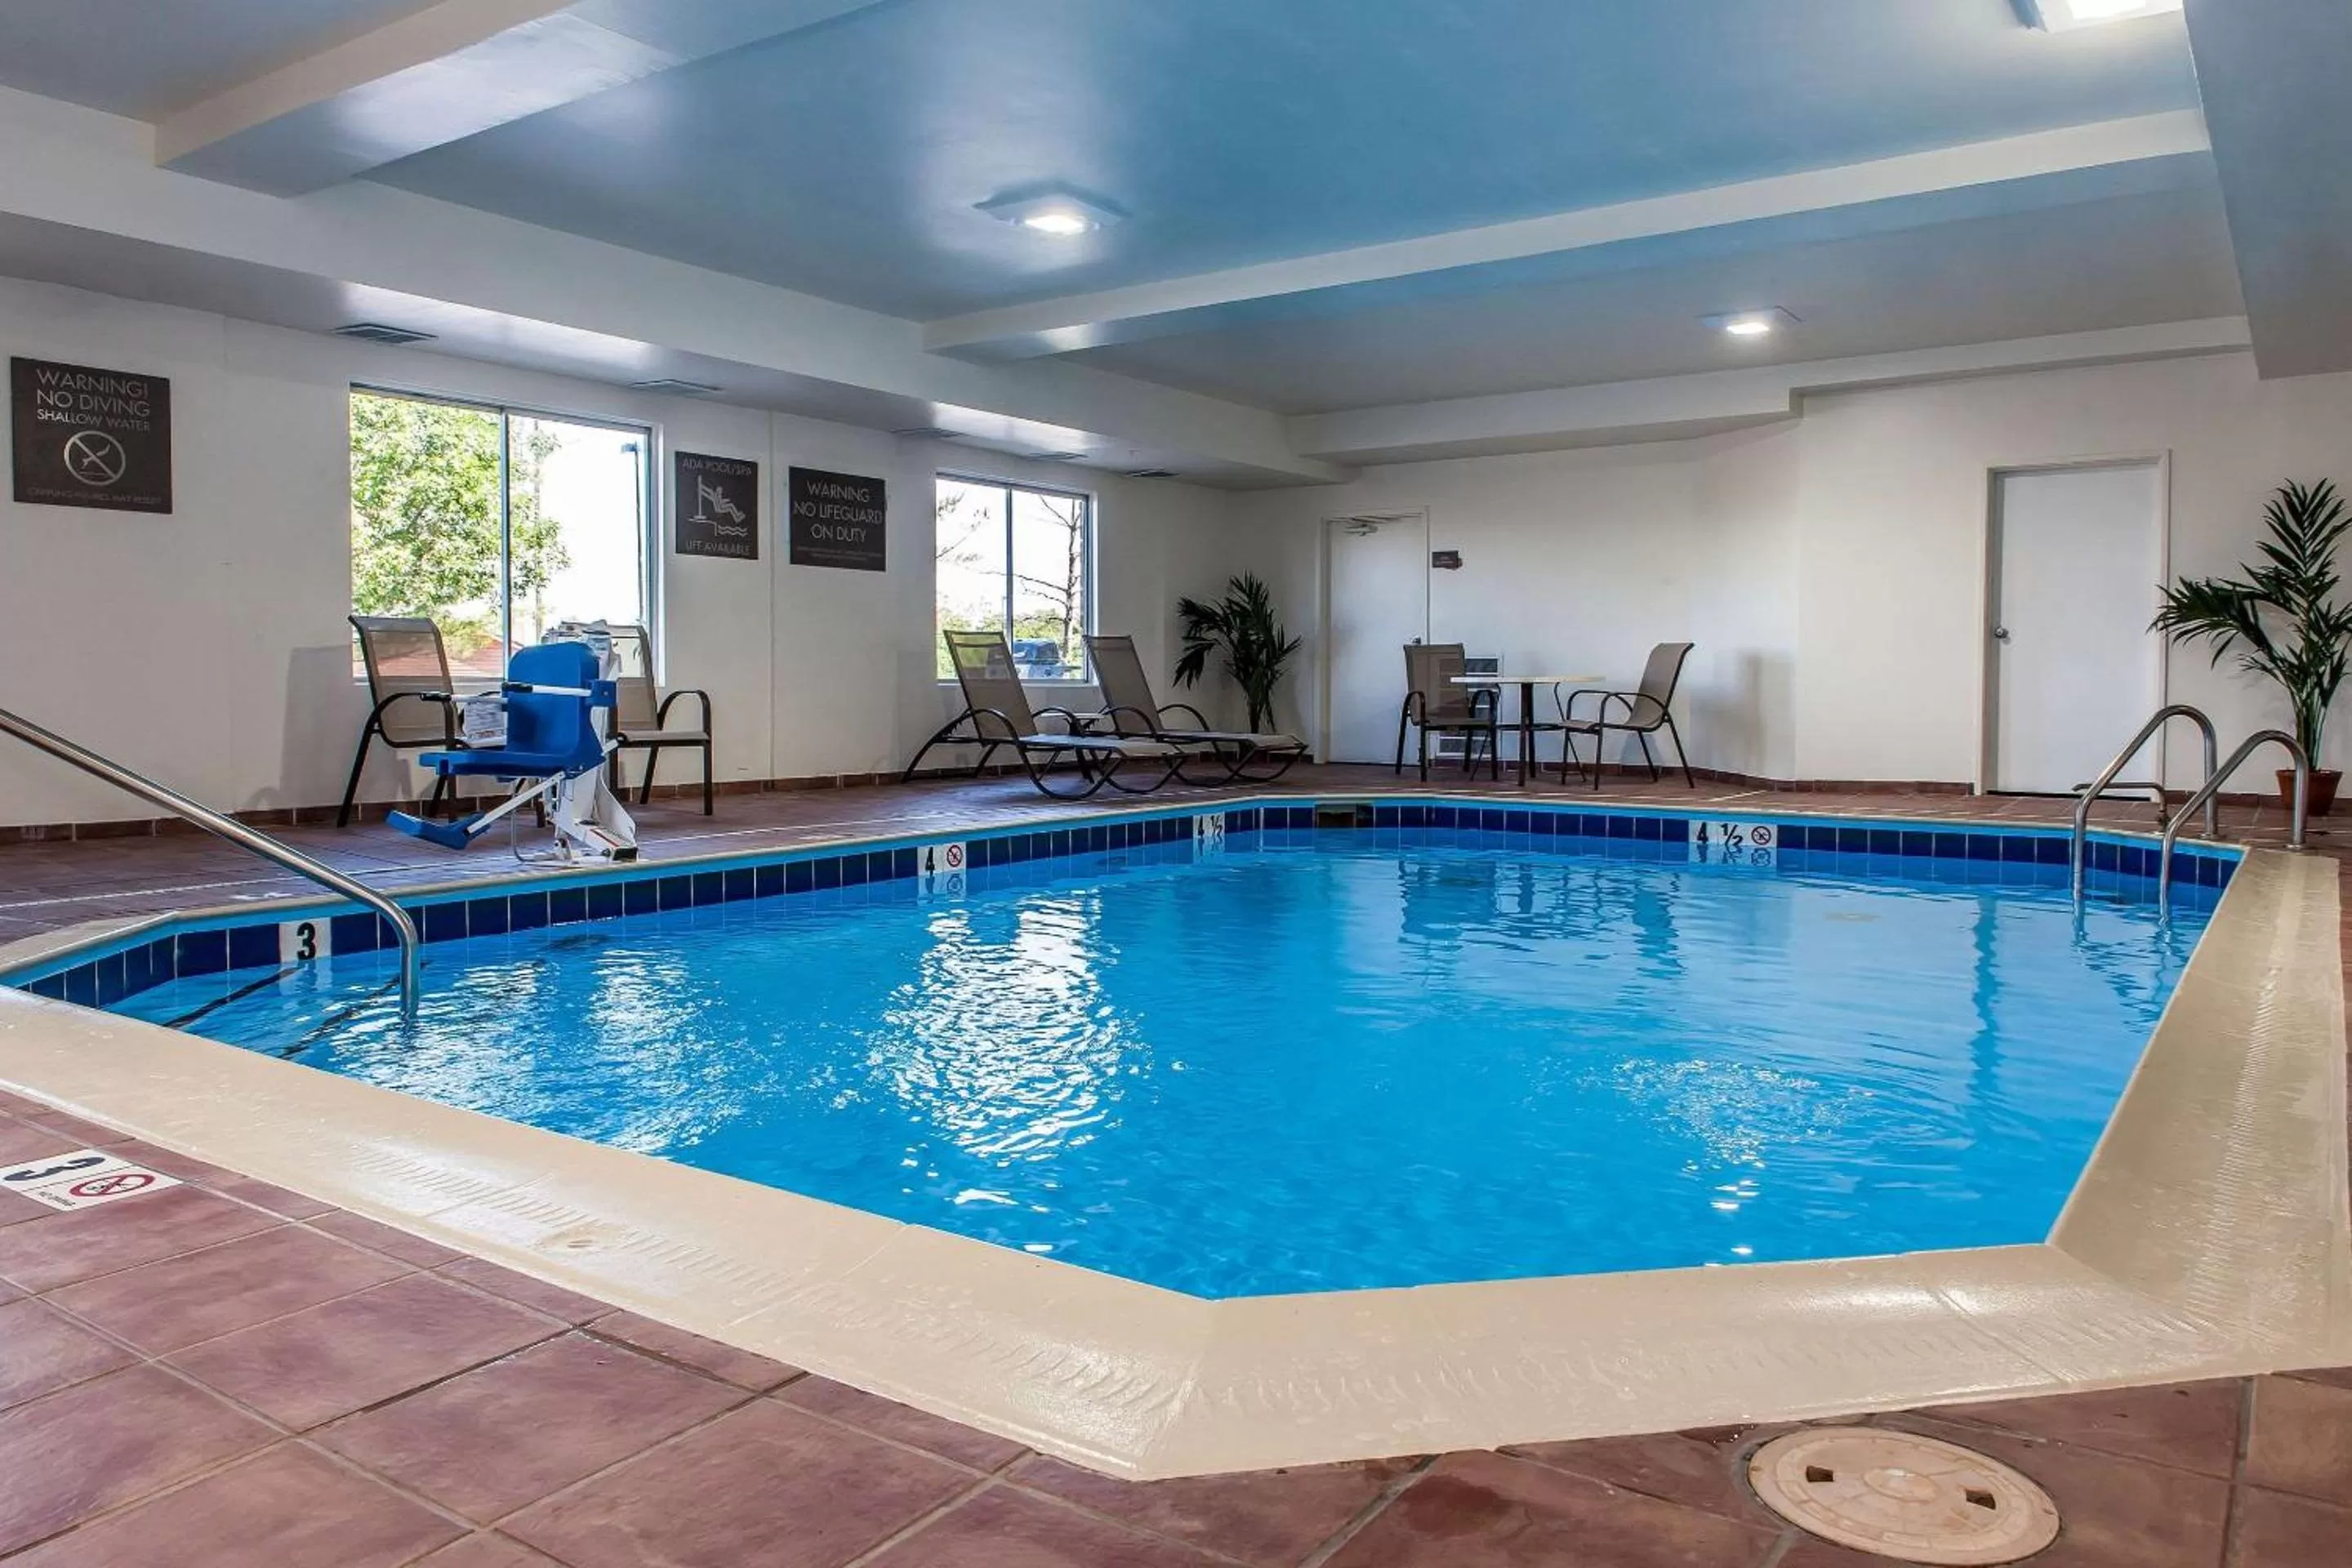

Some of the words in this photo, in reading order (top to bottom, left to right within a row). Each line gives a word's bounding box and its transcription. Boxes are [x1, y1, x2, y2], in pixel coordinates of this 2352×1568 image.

[36, 388, 74, 408] NO
[79, 394, 151, 417] DIVING
[37, 409, 103, 426] SHALLOW
[106, 416, 150, 431] WATER
[682, 457, 703, 472] ADA
[805, 479, 870, 504] WARNING
[794, 499, 817, 518] NO
[819, 502, 884, 525] LIFEGUARD
[811, 523, 834, 541] ON
[836, 526, 866, 544] DUTY
[686, 539, 703, 550] LIFT
[705, 541, 751, 556] AVAILABLE
[1197, 815, 1205, 839] 4
[1697, 822, 1708, 844] 4
[925, 846, 936, 876] 4
[297, 921, 316, 960] 3
